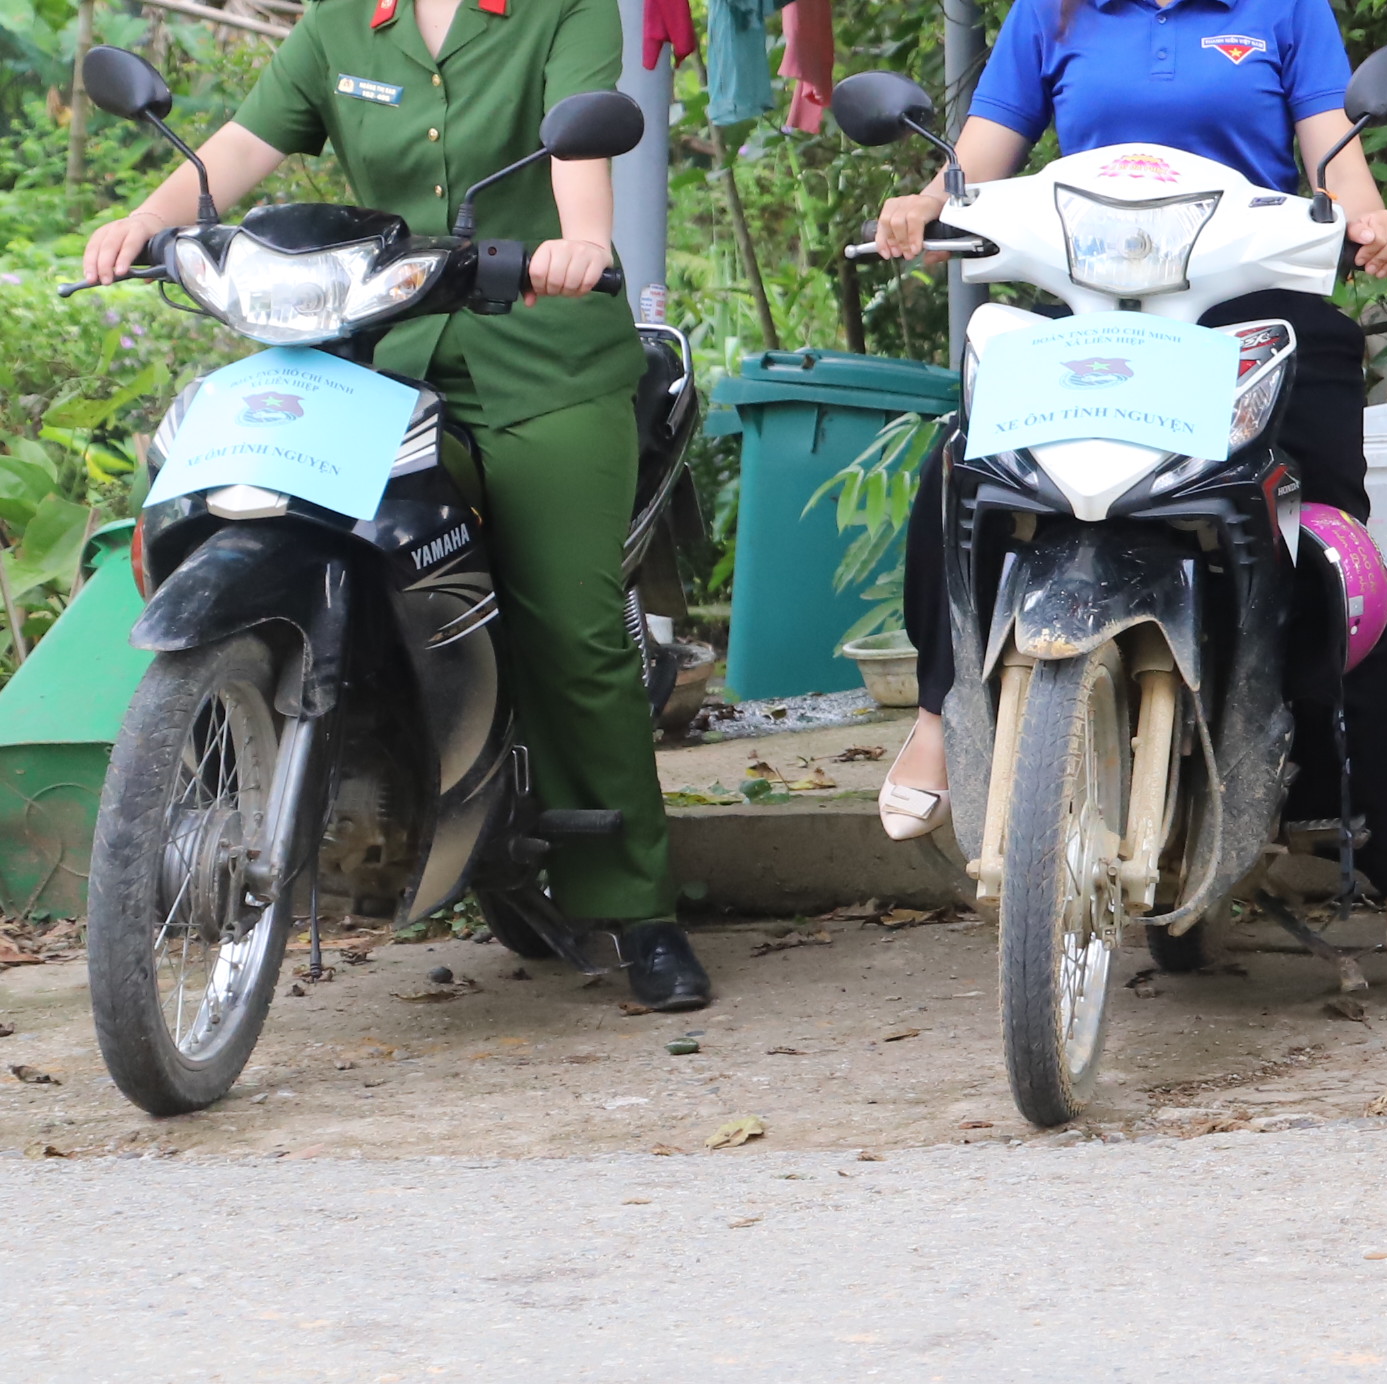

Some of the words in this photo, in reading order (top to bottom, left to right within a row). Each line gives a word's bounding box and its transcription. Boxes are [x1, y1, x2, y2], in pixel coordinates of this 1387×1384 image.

[1064, 337, 1082, 348] XÃ
[1085, 336, 1113, 346] LIÊN
[1115, 337, 1146, 348] HIỆP
[1070, 327, 1100, 338] TNCS
[1101, 326, 1122, 335] HỒ
[1122, 327, 1147, 337] CHÍ
[1148, 330, 1182, 344] MINH
[282, 367, 299, 377] HỒ
[301, 370, 323, 384] CHÍ
[325, 378, 355, 395] MINH
[994, 418, 1020, 435] XE
[1023, 410, 1056, 427] ÔM
[1060, 405, 1109, 419] TÌNH
[1113, 408, 1196, 435] NGUYỆN
[230, 442, 270, 455] TÌNH
[271, 445, 342, 476] NGUYỆN
[1277, 482, 1300, 497] HONDA
[410, 522, 471, 571] YAMAHA
